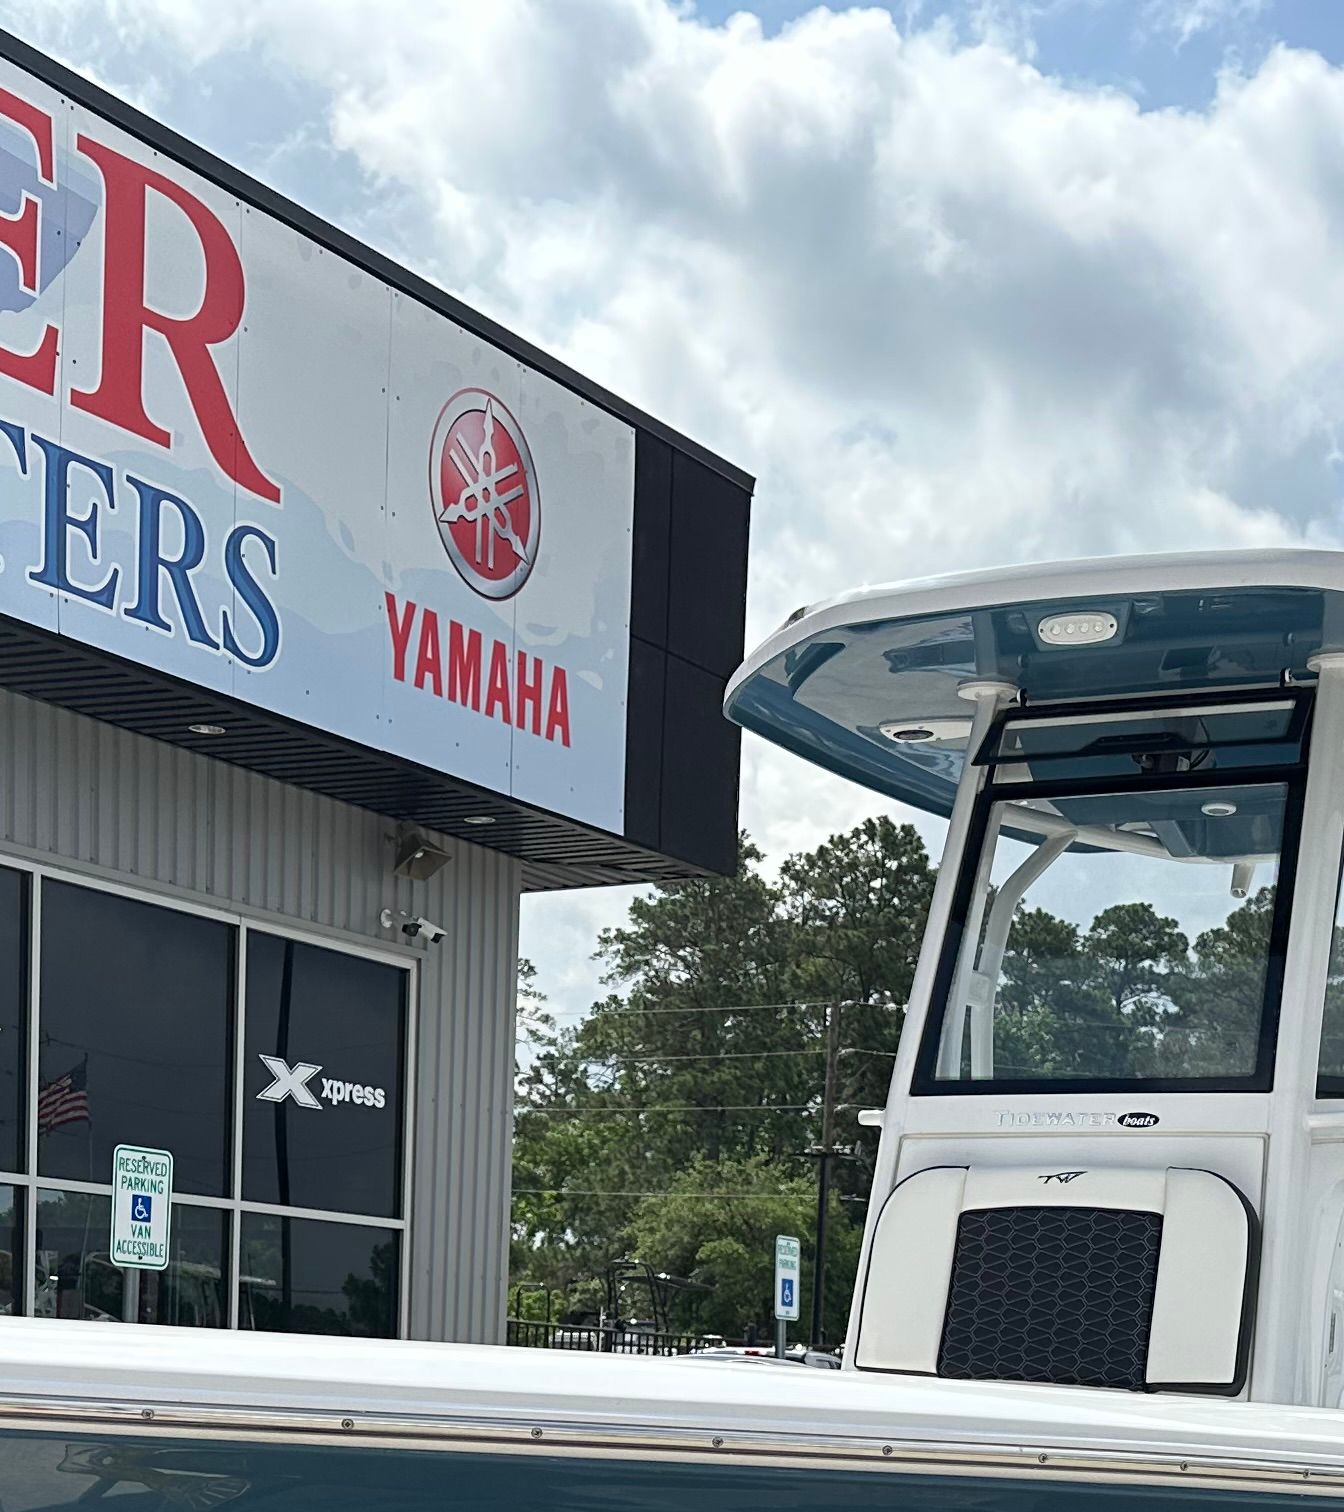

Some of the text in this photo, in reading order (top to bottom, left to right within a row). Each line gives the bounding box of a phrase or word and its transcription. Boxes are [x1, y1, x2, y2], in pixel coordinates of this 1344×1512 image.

[384, 590, 571, 748] YAMAHA
[321, 1077, 386, 1108] xpress
[994, 1109, 1156, 1127] TIDEWATER boats
[118, 1156, 168, 1177] RESERVED
[121, 1175, 164, 1195] PARKING
[131, 1224, 151, 1239] VAN
[116, 1239, 164, 1258] ACCESSIBLE
